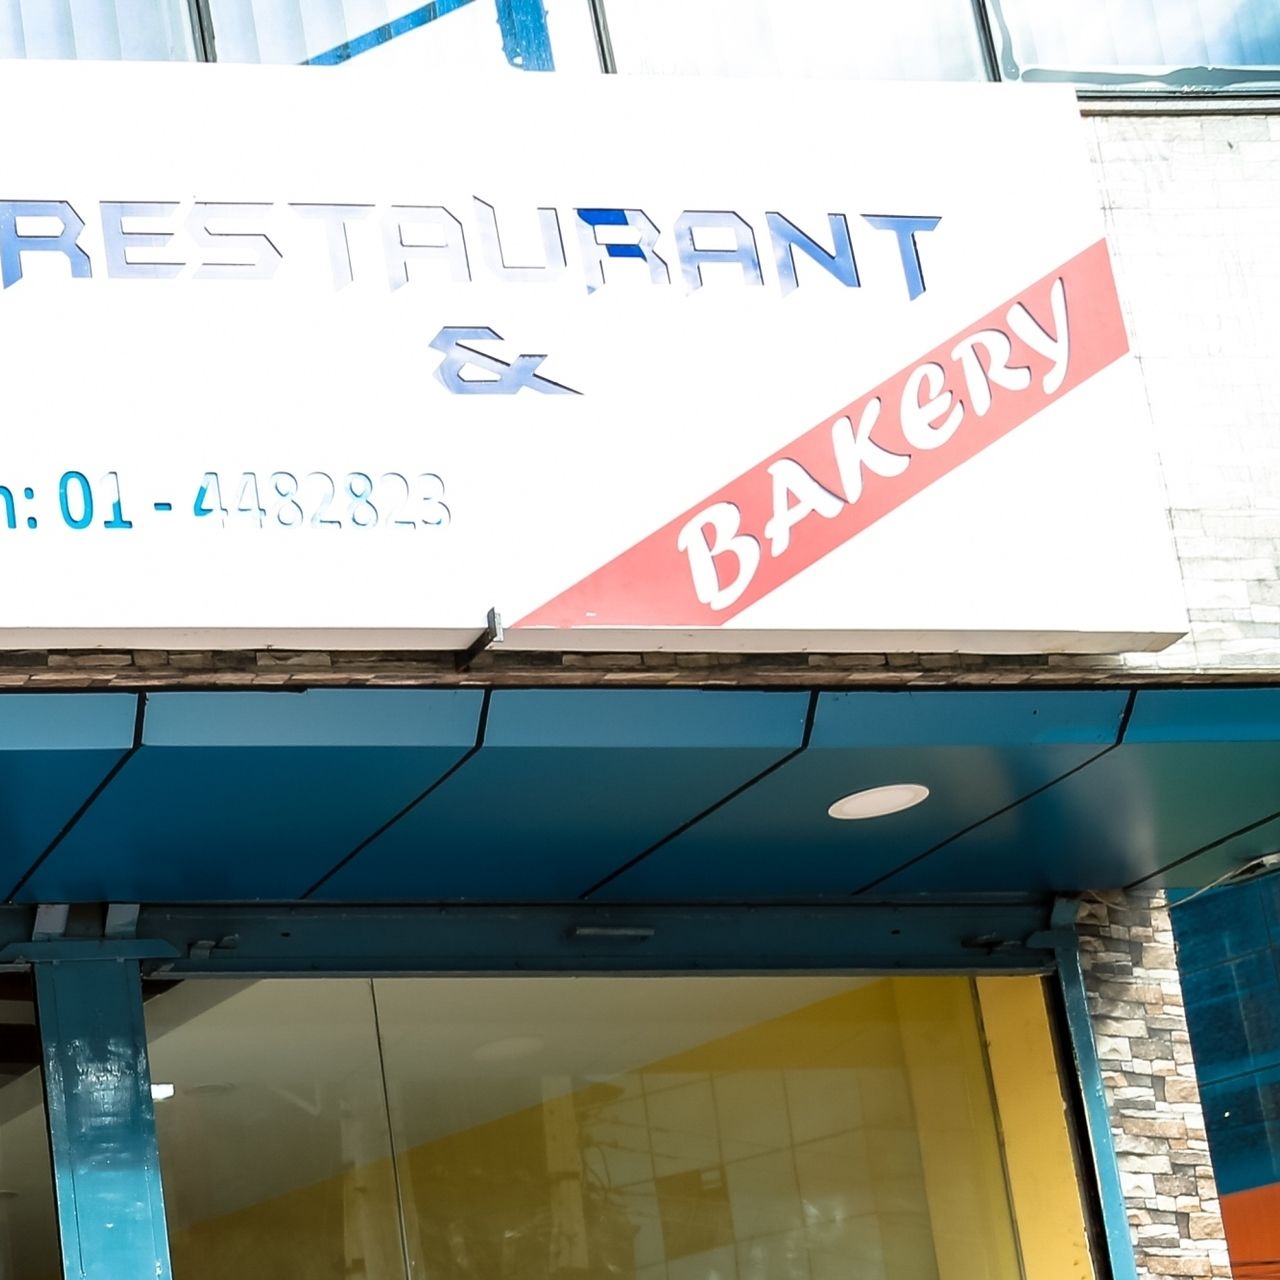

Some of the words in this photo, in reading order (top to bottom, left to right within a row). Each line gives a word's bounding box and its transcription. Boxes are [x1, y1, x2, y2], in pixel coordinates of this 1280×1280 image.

[428, 325, 585, 396] &
[58, 470, 133, 530] 01
[193, 470, 451, 530] 4482823
